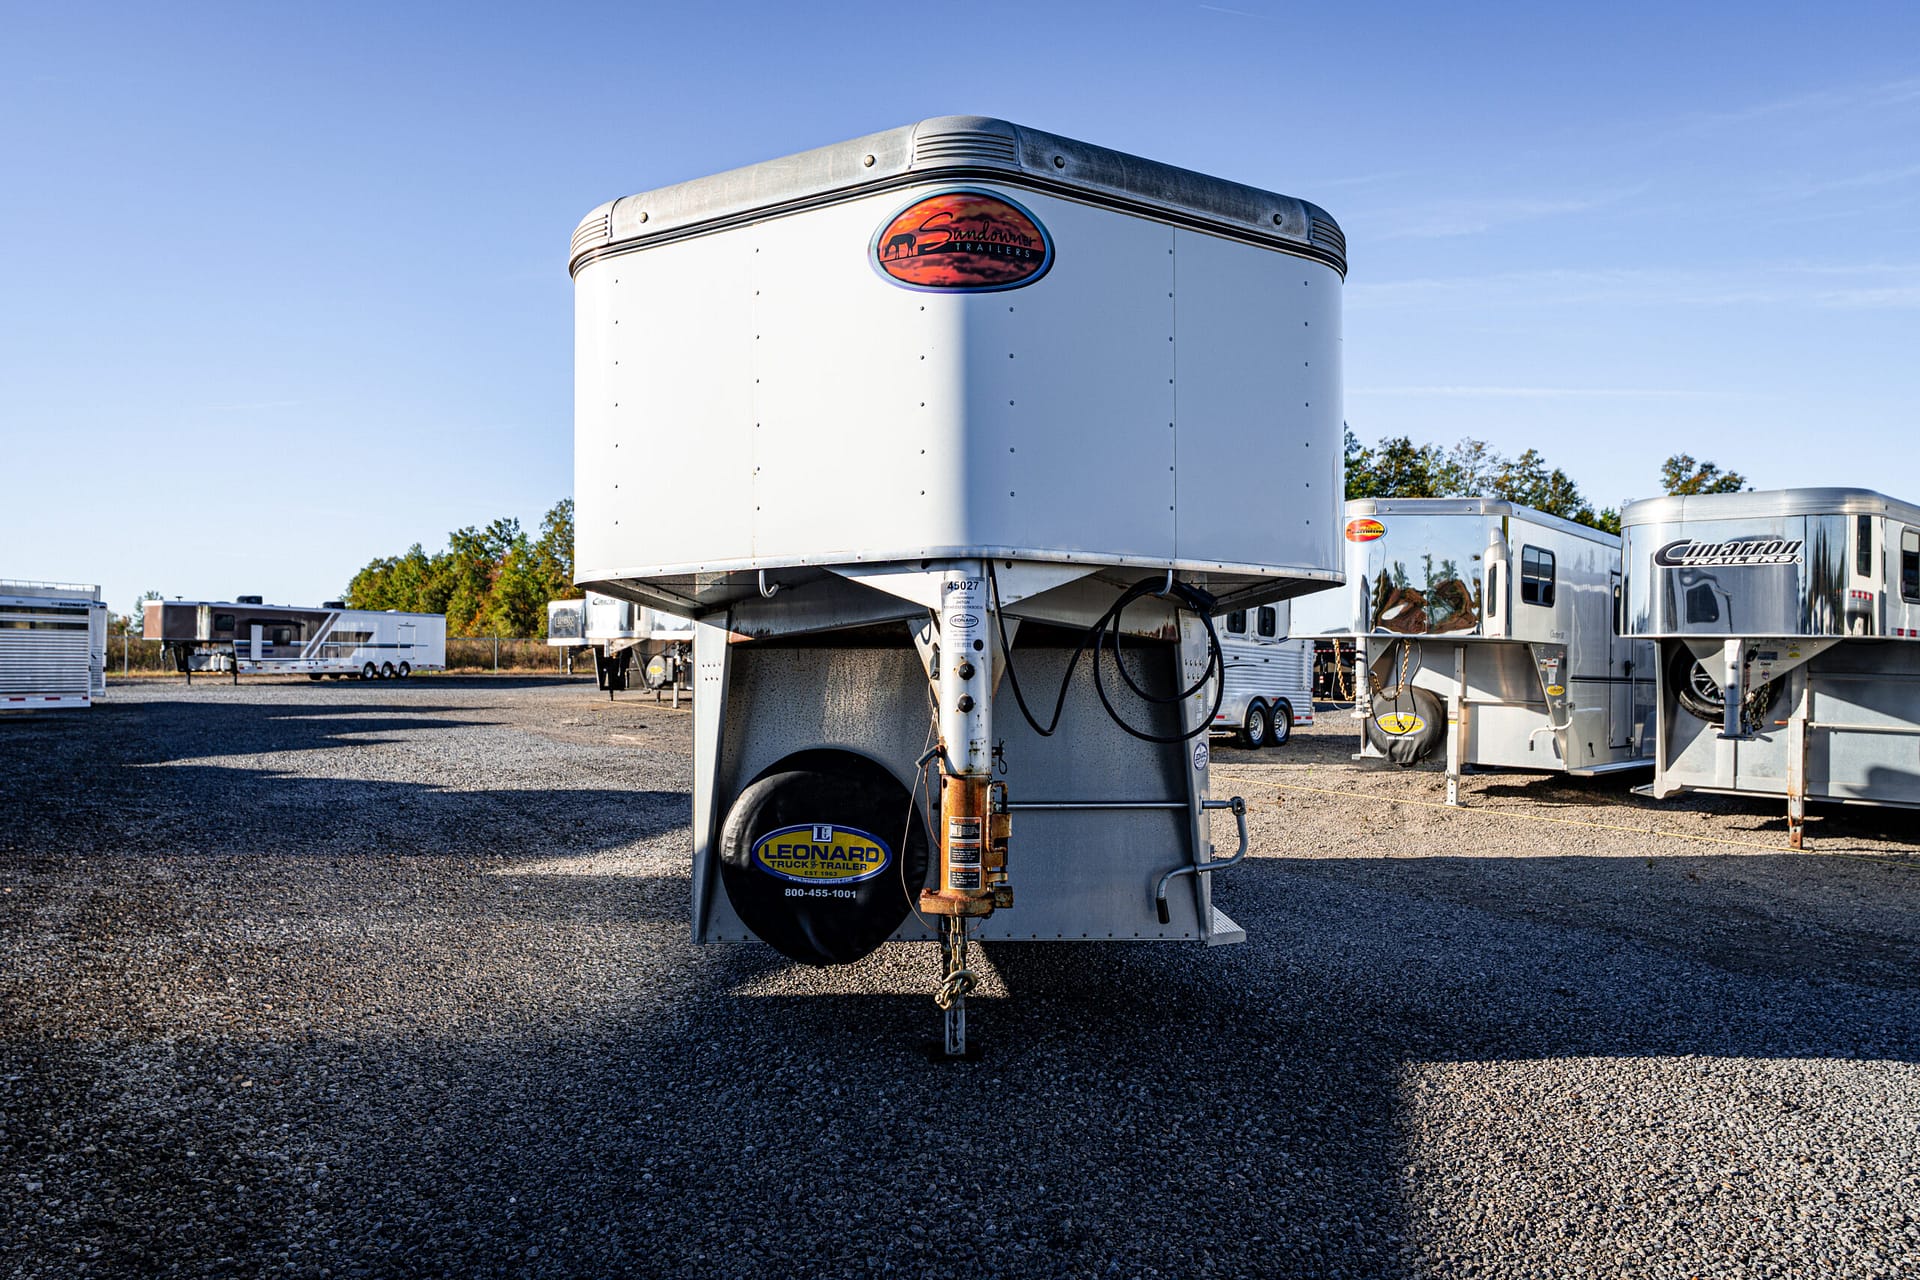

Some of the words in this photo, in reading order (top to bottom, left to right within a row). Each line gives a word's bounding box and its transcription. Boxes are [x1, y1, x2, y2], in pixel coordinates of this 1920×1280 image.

[955, 242, 1031, 257] TRAILERS
[1654, 538, 1802, 566] Cimarron
[1681, 555, 1793, 566] TRAILERS
[947, 581, 979, 591] 45027
[764, 844, 880, 863] LEONARD
[769, 860, 809, 869] TRUCK
[820, 861, 867, 871] TRAILER
[784, 888, 857, 899] 800-455-1001
